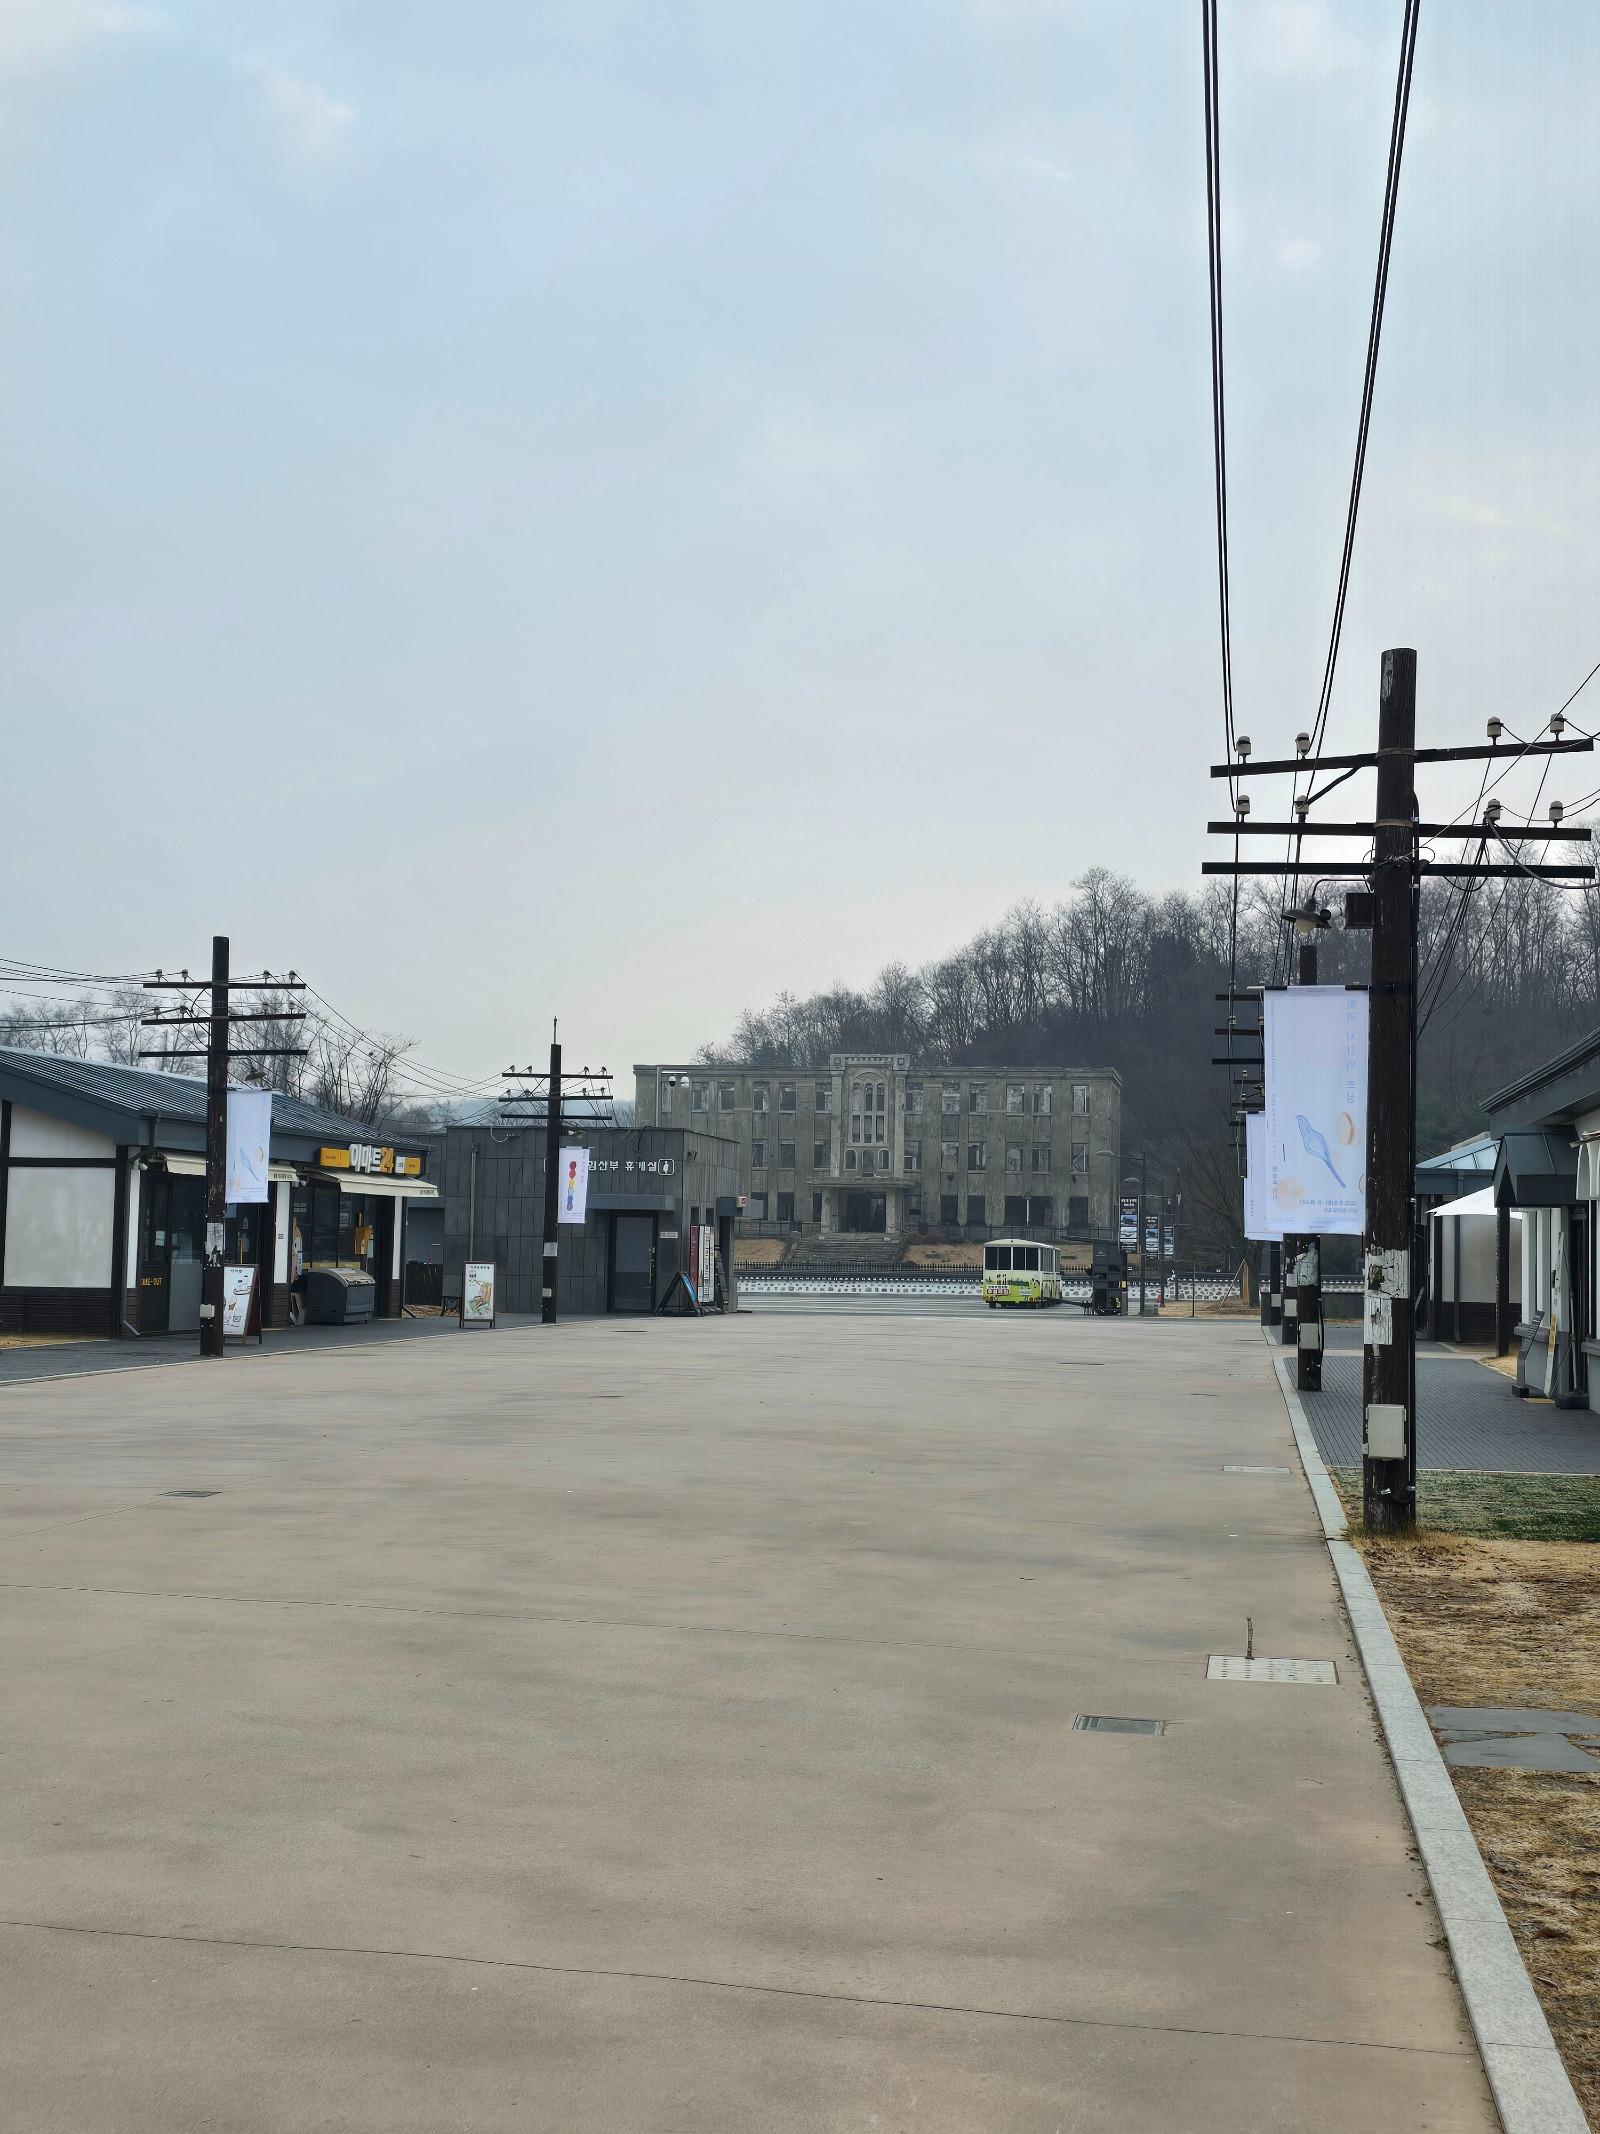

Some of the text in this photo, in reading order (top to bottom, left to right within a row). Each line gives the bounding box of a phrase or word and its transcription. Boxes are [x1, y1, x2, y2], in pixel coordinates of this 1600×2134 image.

[349, 1144, 394, 1173] 이마트24
[588, 1160, 657, 1172] 임산부 휴게실
